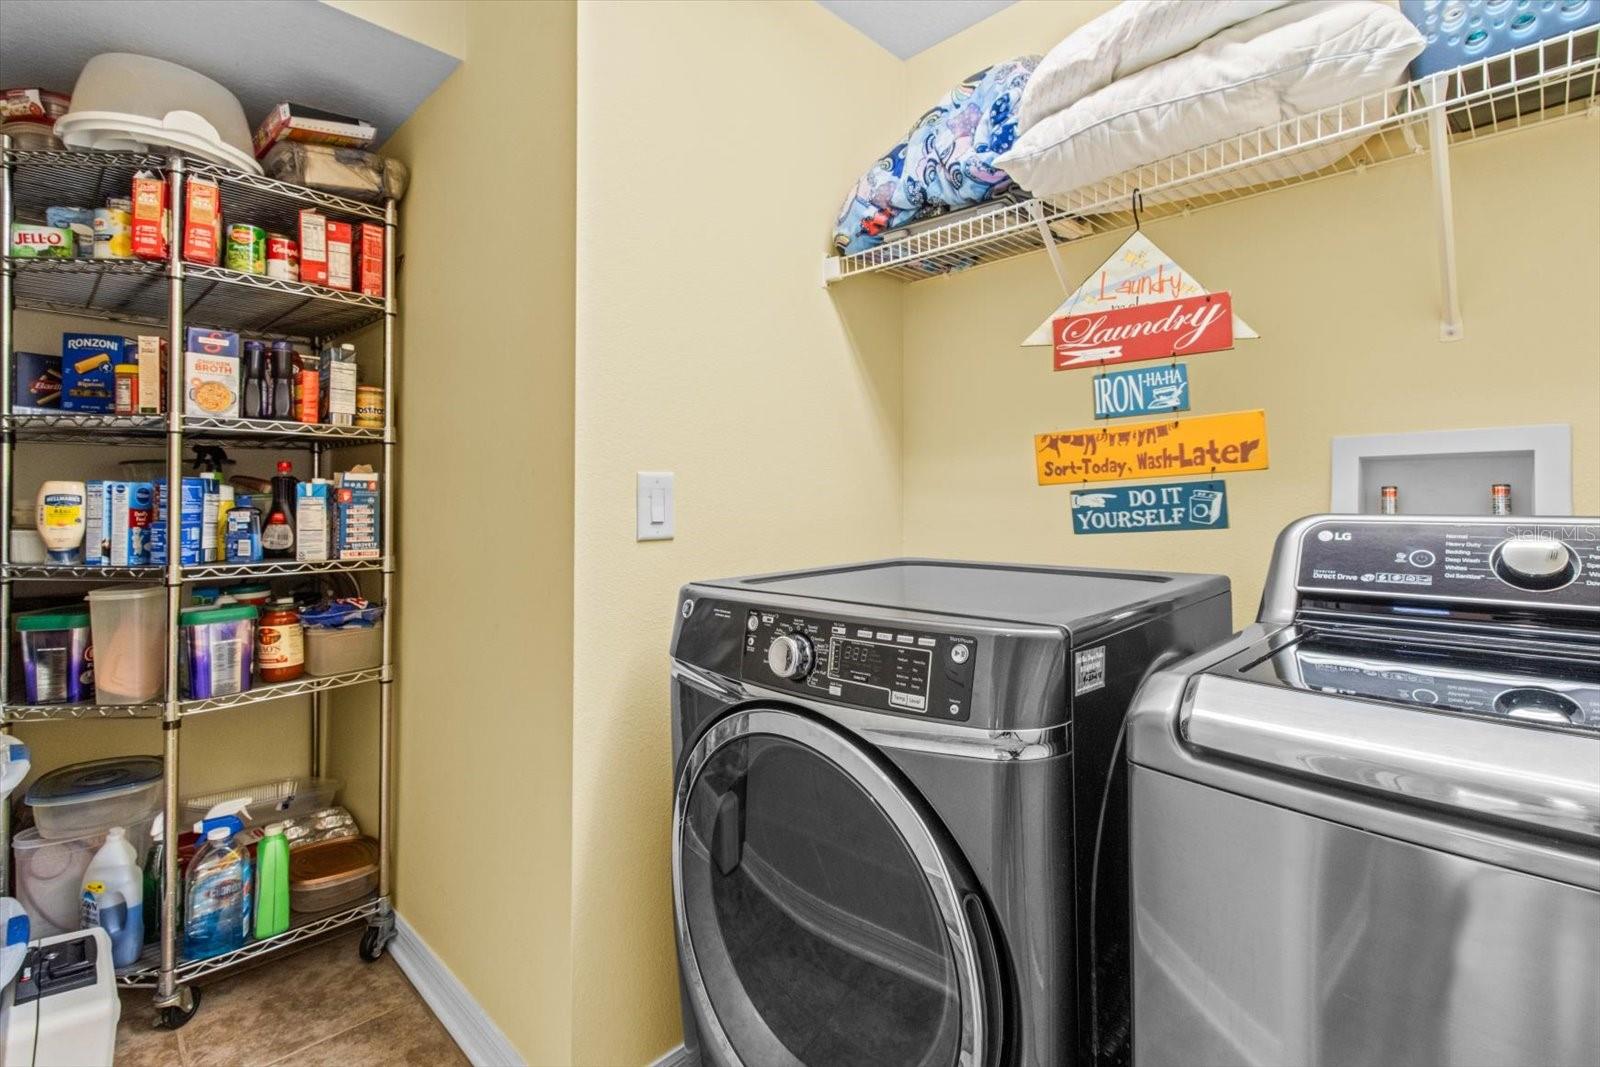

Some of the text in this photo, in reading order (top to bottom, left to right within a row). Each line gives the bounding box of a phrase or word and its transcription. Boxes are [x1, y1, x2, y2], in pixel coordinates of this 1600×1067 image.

[1098, 264, 1182, 301] Laundry
[1056, 303, 1227, 350] Laundry
[68, 338, 118, 350] RONZONI
[195, 363, 232, 375] BROTH
[1137, 439, 1259, 470] Wash-Later
[1128, 487, 1183, 507] DO IT
[1077, 508, 1185, 530] YOURSELF
[1335, 532, 1352, 541] LG
